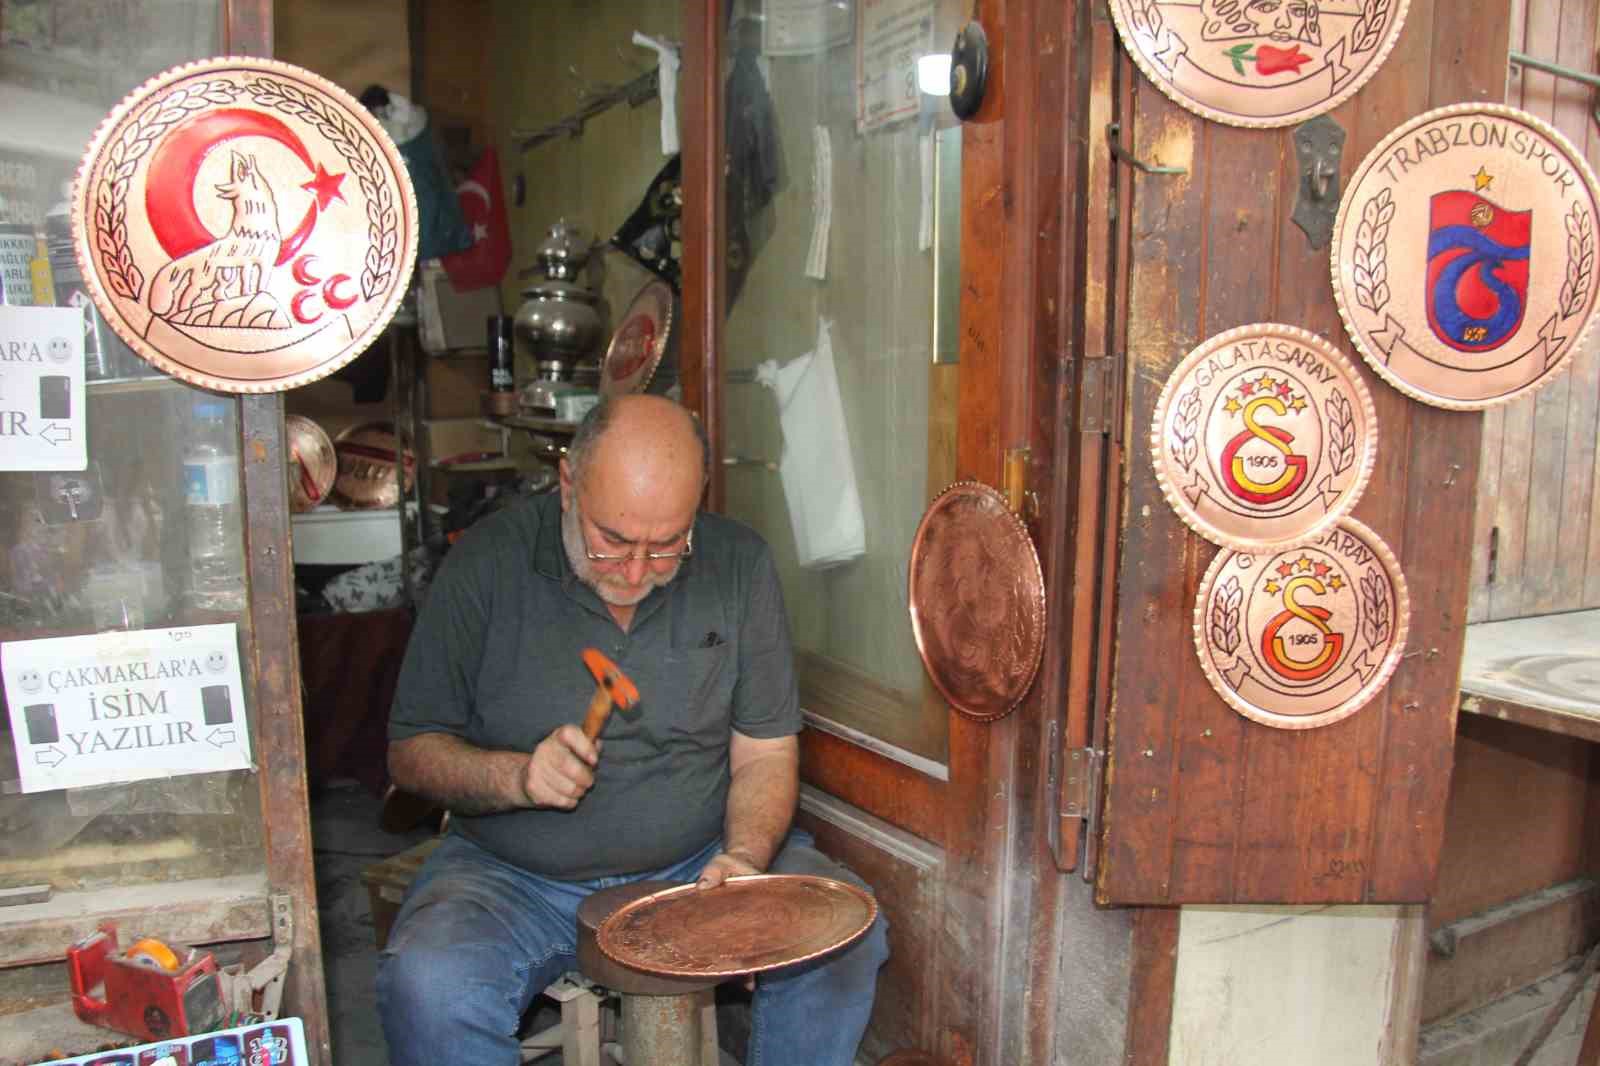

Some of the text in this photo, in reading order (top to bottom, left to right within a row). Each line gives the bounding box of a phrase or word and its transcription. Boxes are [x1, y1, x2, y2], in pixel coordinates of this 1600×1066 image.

[1378, 122, 1575, 198] TRABZONSPOR
[1195, 341, 1337, 386] GALATASARAY
[1247, 455, 1279, 468] 1905
[1288, 633, 1318, 646] 1905
[48, 658, 203, 693] ÇAKMAKLAR'A
[89, 688, 169, 721] İSİM
[66, 721, 200, 755] YAZILIR
